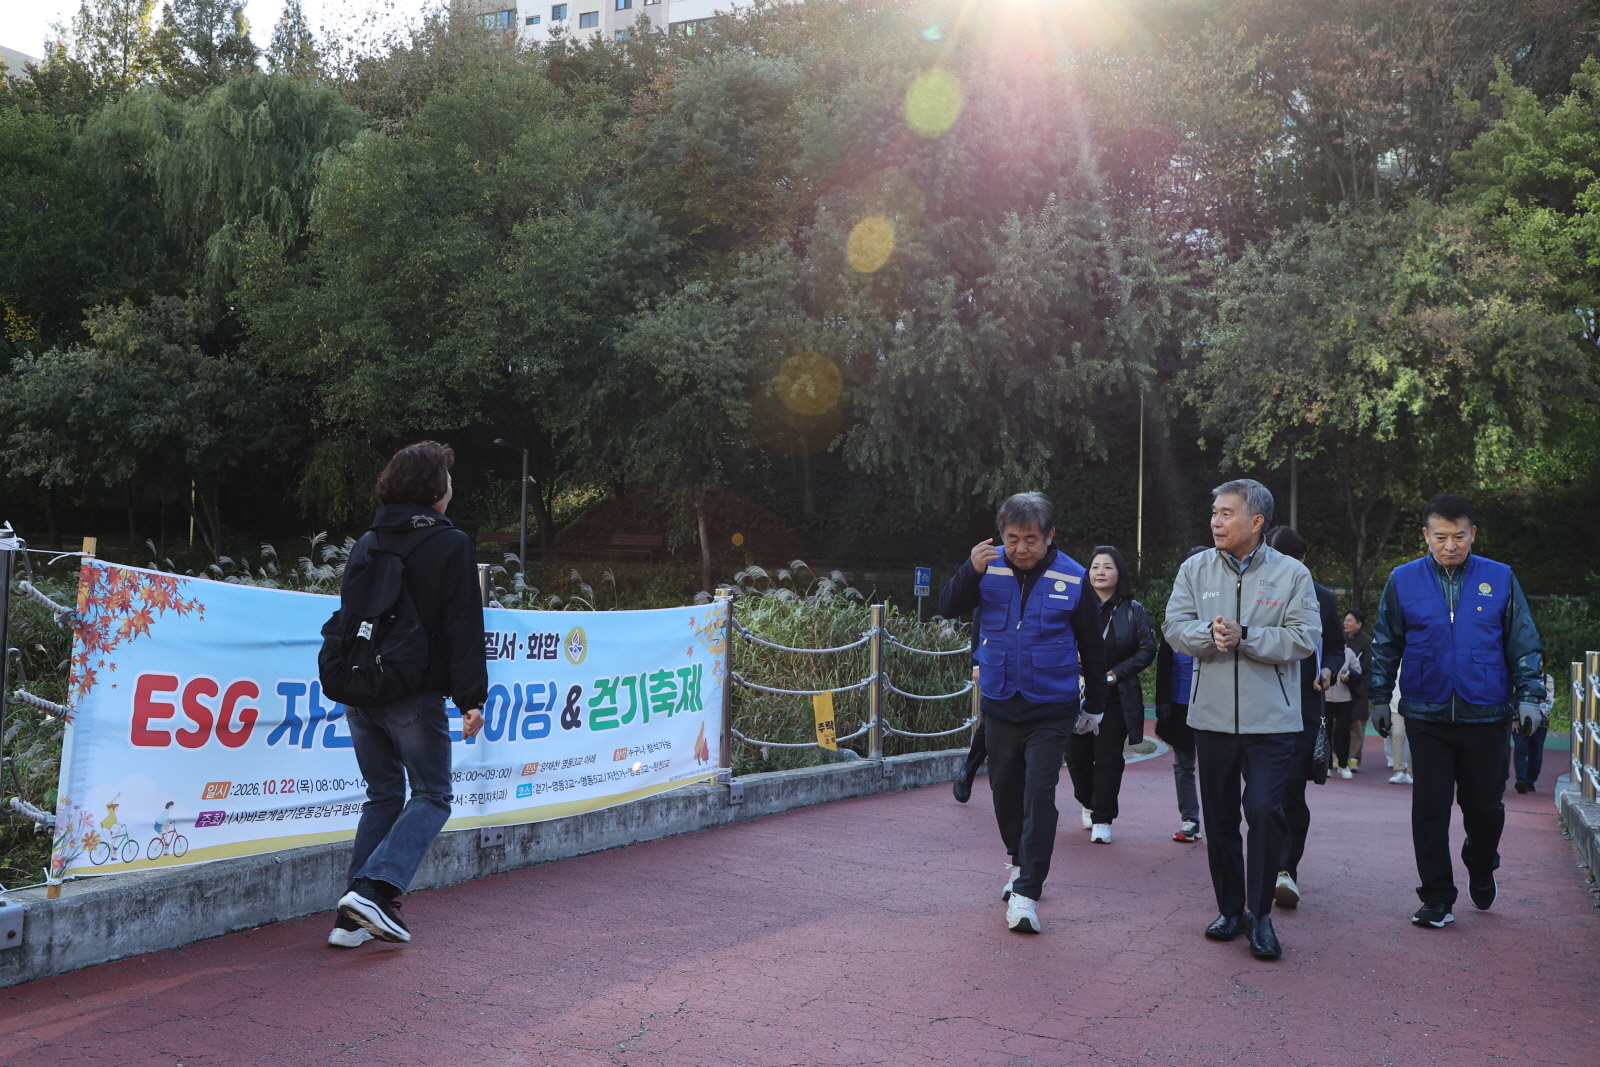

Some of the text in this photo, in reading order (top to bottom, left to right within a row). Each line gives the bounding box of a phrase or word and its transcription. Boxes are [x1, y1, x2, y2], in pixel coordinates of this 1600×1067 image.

[131, 674, 259, 748] ESG
[447, 681, 557, 744] 이딩
[588, 663, 703, 731] 걷기축제
[817, 720, 835, 734] 추락
[615, 749, 627, 760] 참석
[524, 764, 537, 775] 장소
[206, 784, 228, 798] 일시
[517, 785, 531, 797] 코스
[199, 814, 223, 827] 주최
